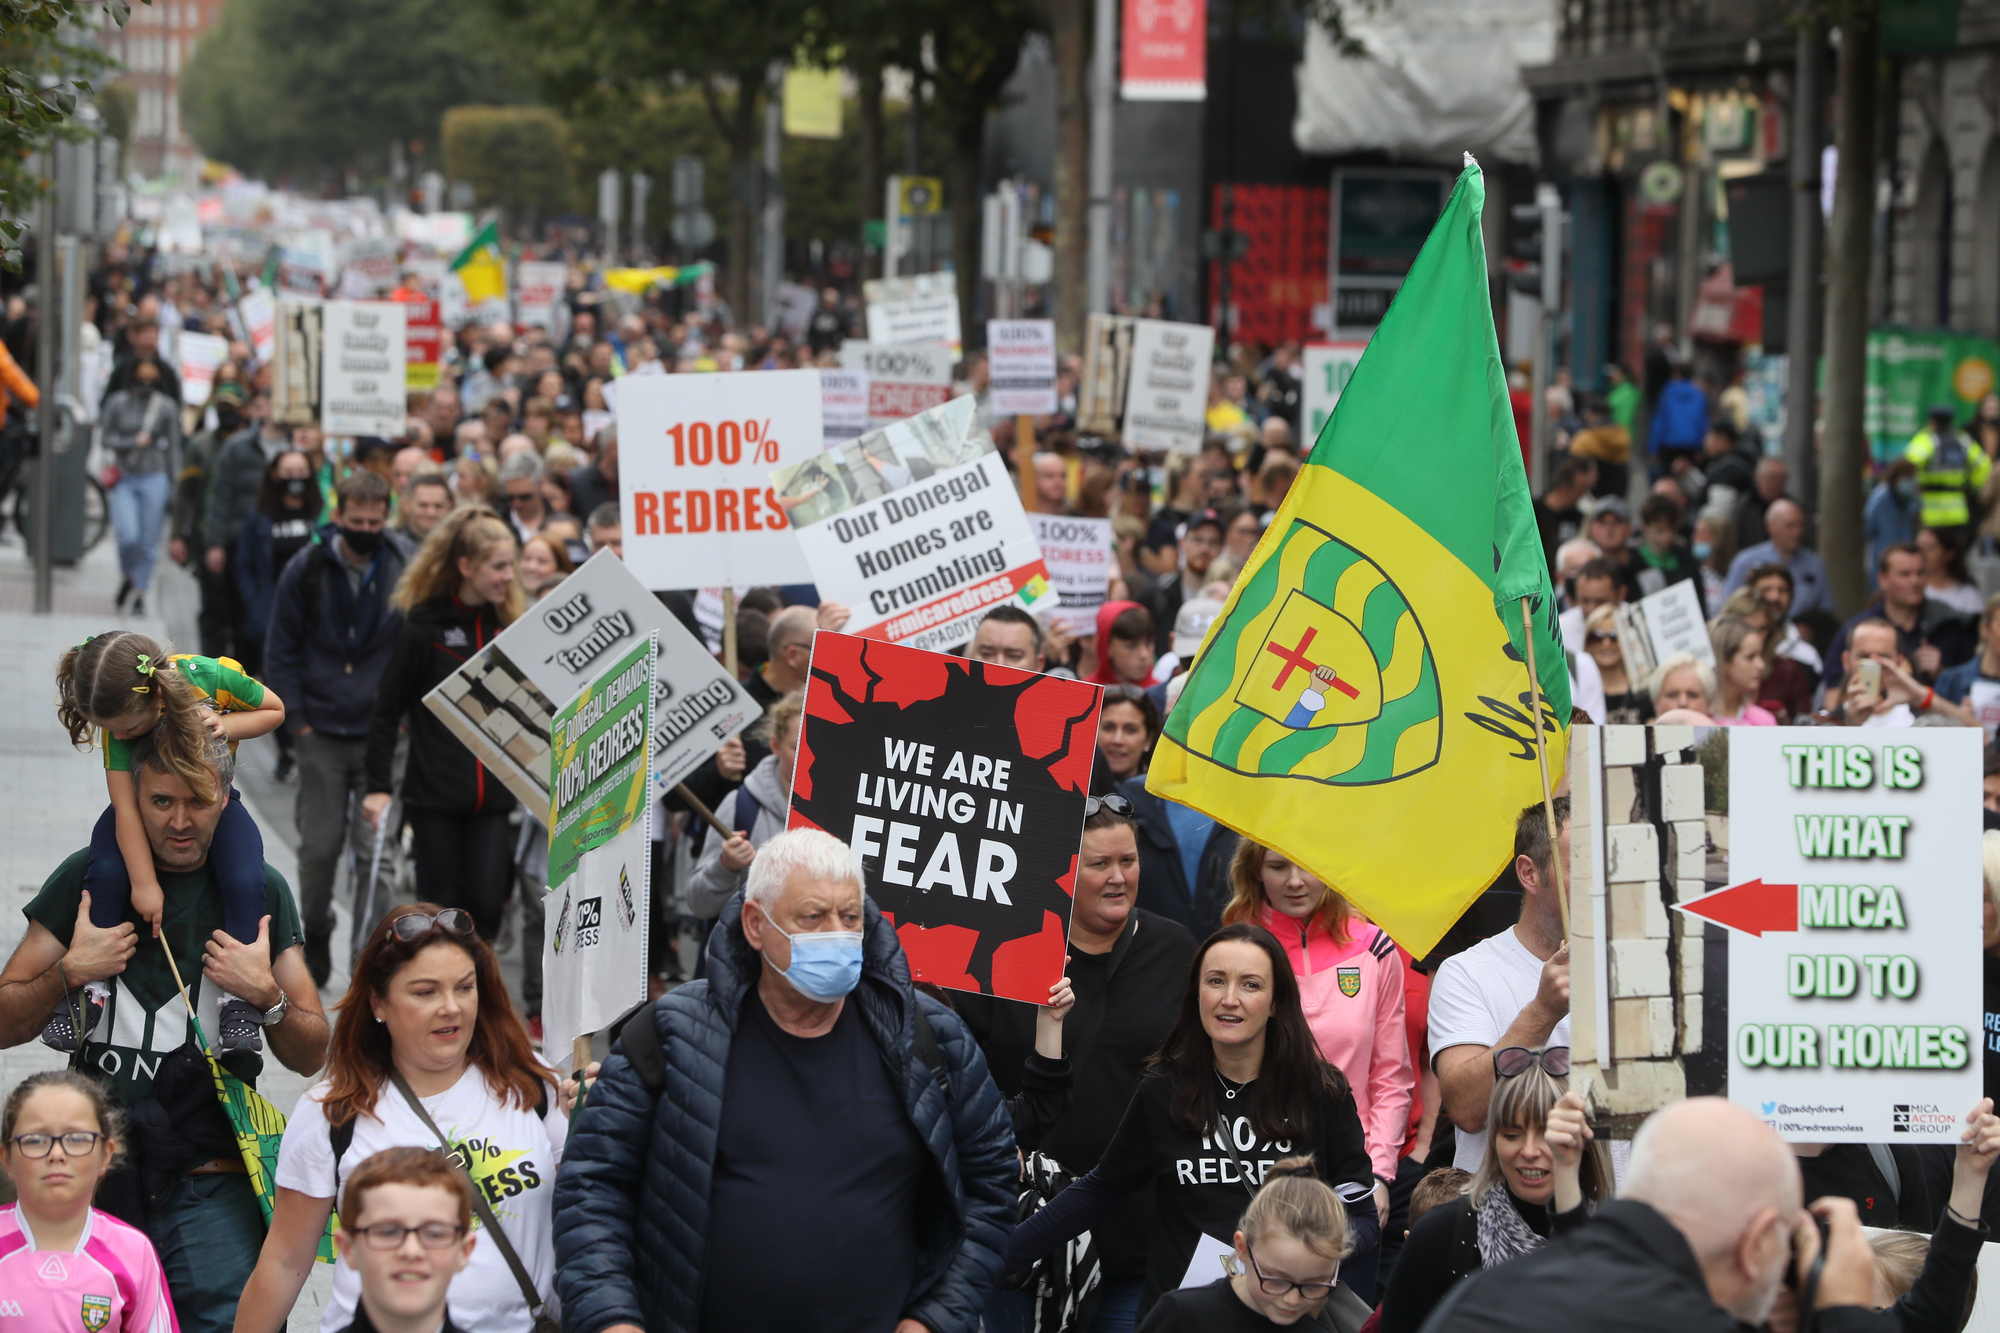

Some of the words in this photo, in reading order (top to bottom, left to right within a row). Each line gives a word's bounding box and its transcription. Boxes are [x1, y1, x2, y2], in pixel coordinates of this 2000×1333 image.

[863, 352, 935, 379] 100%
[666, 418, 779, 466] 100%
[634, 486, 789, 535] REDRES
[882, 463, 991, 525] Donegal
[855, 527, 946, 579] Homes
[950, 508, 993, 543] are
[1039, 521, 1099, 543] 100%
[1041, 545, 1105, 565] EDRESS
[543, 594, 589, 635] Our
[556, 609, 631, 674] family
[566, 691, 604, 749] DONEGAL
[606, 652, 649, 714] DEMANDS
[555, 751, 586, 812] 100%
[588, 702, 643, 785] REDRESS
[884, 736, 935, 776] WE
[942, 751, 1011, 792] ARE
[1782, 744, 1873, 788] THIS
[1882, 745, 1923, 788] IS
[856, 772, 976, 824] LIVING
[986, 799, 1024, 835] IN
[1794, 814, 1910, 858] WHAT
[850, 814, 1018, 906] FEAR
[1801, 885, 1906, 928] MICA
[1787, 954, 1857, 998] DID
[1864, 955, 1918, 998] TO
[1736, 1023, 1819, 1068] OUR
[1828, 1025, 1969, 1070] HOMES
[1911, 1104, 1940, 1113] MICA
[1911, 1114, 1956, 1123] ACTION
[1911, 1124, 1951, 1134] GROUP
[1176, 1158, 1276, 1185] REDRE
